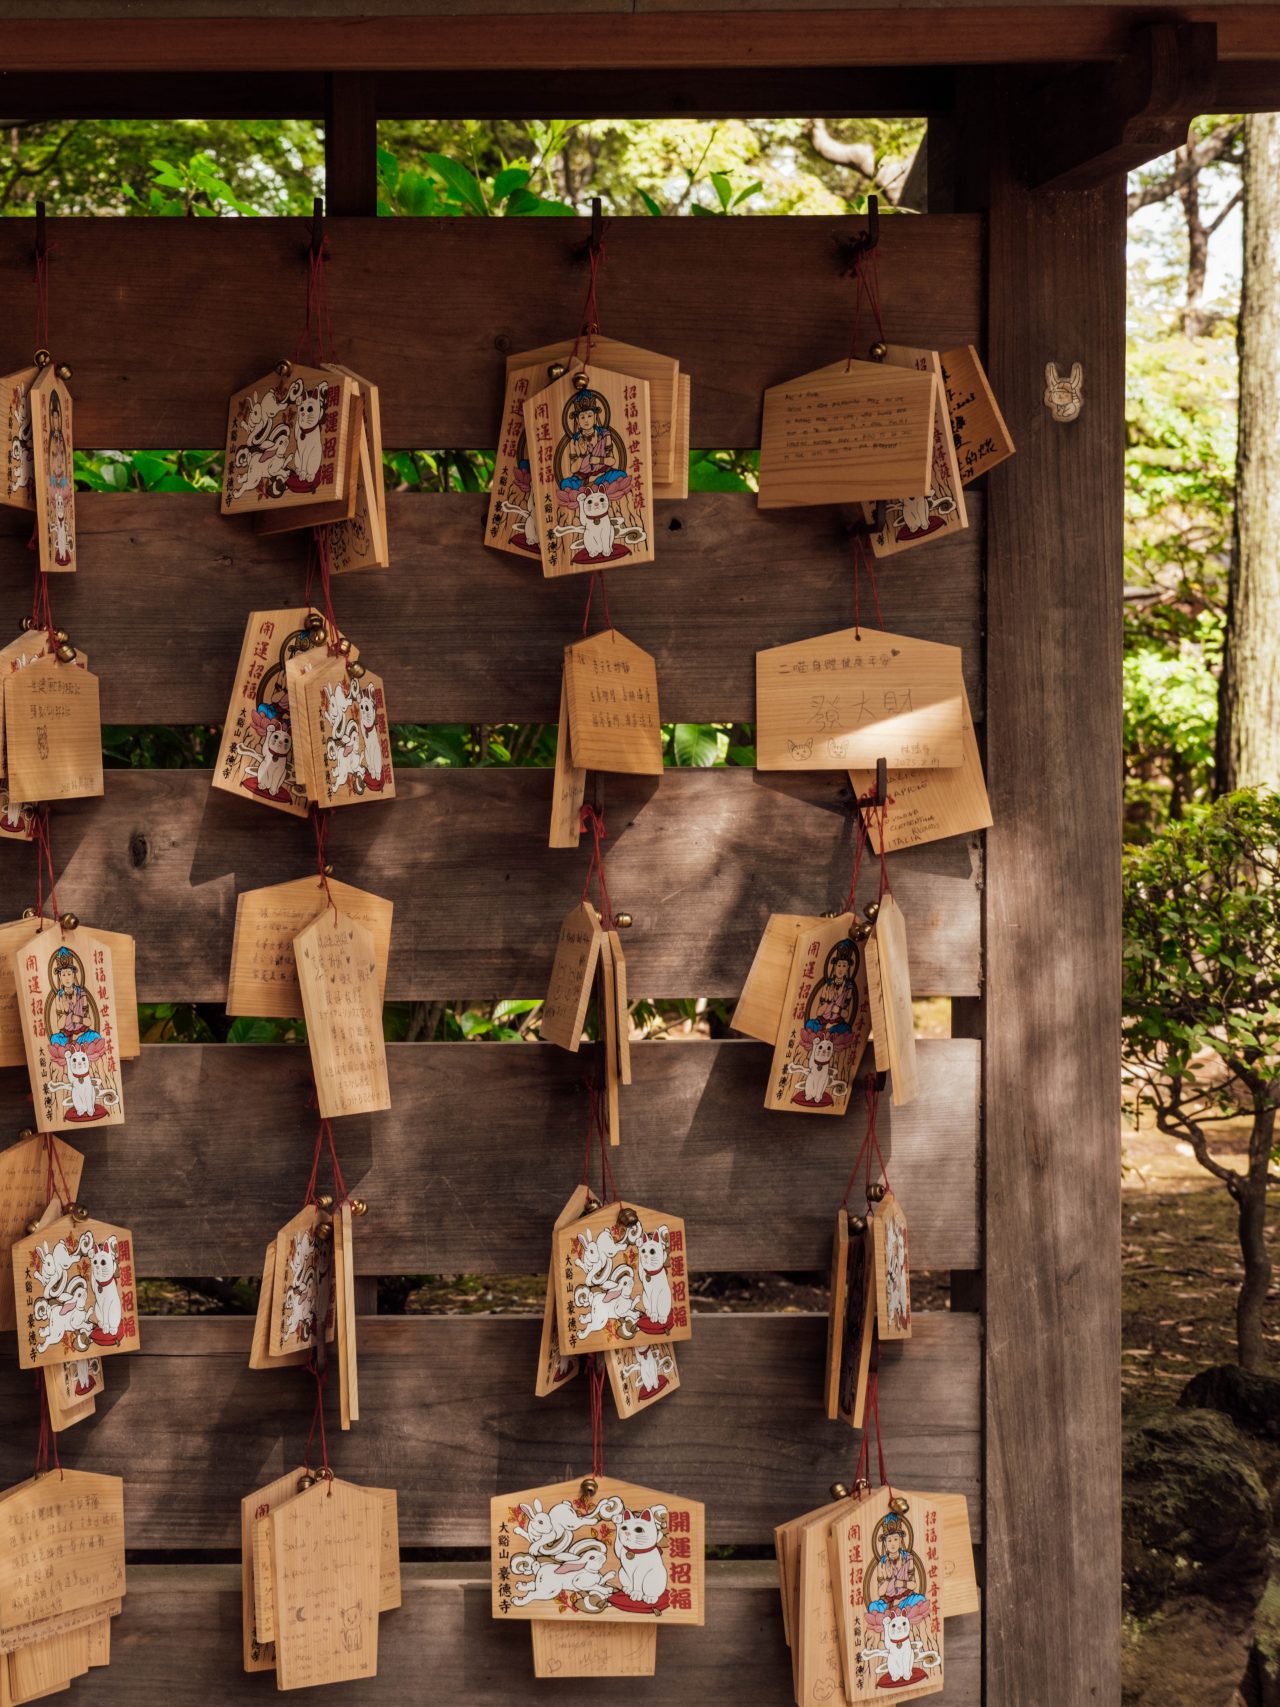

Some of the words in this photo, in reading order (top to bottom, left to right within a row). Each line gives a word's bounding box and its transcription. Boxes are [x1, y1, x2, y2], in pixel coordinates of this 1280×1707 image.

[321, 385, 341, 485] 開運招福
[502, 378, 529, 458] 開運招福
[534, 403, 554, 484] 開運招福
[623, 384, 646, 510] 招福観世音菩薩
[242, 621, 274, 700] 開運招福
[375, 687, 393, 785] 開運招福
[807, 688, 915, 732] 發大財
[25, 955, 45, 1038] 開運招福
[93, 949, 117, 1073] 招福観世音菩薩
[793, 941, 821, 1021] 開運招福
[24, 1266, 33, 1308] 大谿山
[118, 1239, 137, 1338] 開運招福
[565, 1255, 574, 1293] 大谿山
[669, 1230, 688, 1328] 開運招福
[26, 1312, 37, 1363] 豪徳寺
[566, 1300, 577, 1349] 豪徳寺
[498, 1522, 510, 1560] 大谿山
[668, 1511, 692, 1610] 開運招福
[847, 1524, 864, 1608] 開運招福
[925, 1511, 941, 1633] 招福観世音菩薩
[497, 1565, 512, 1615] 豪徳寺
